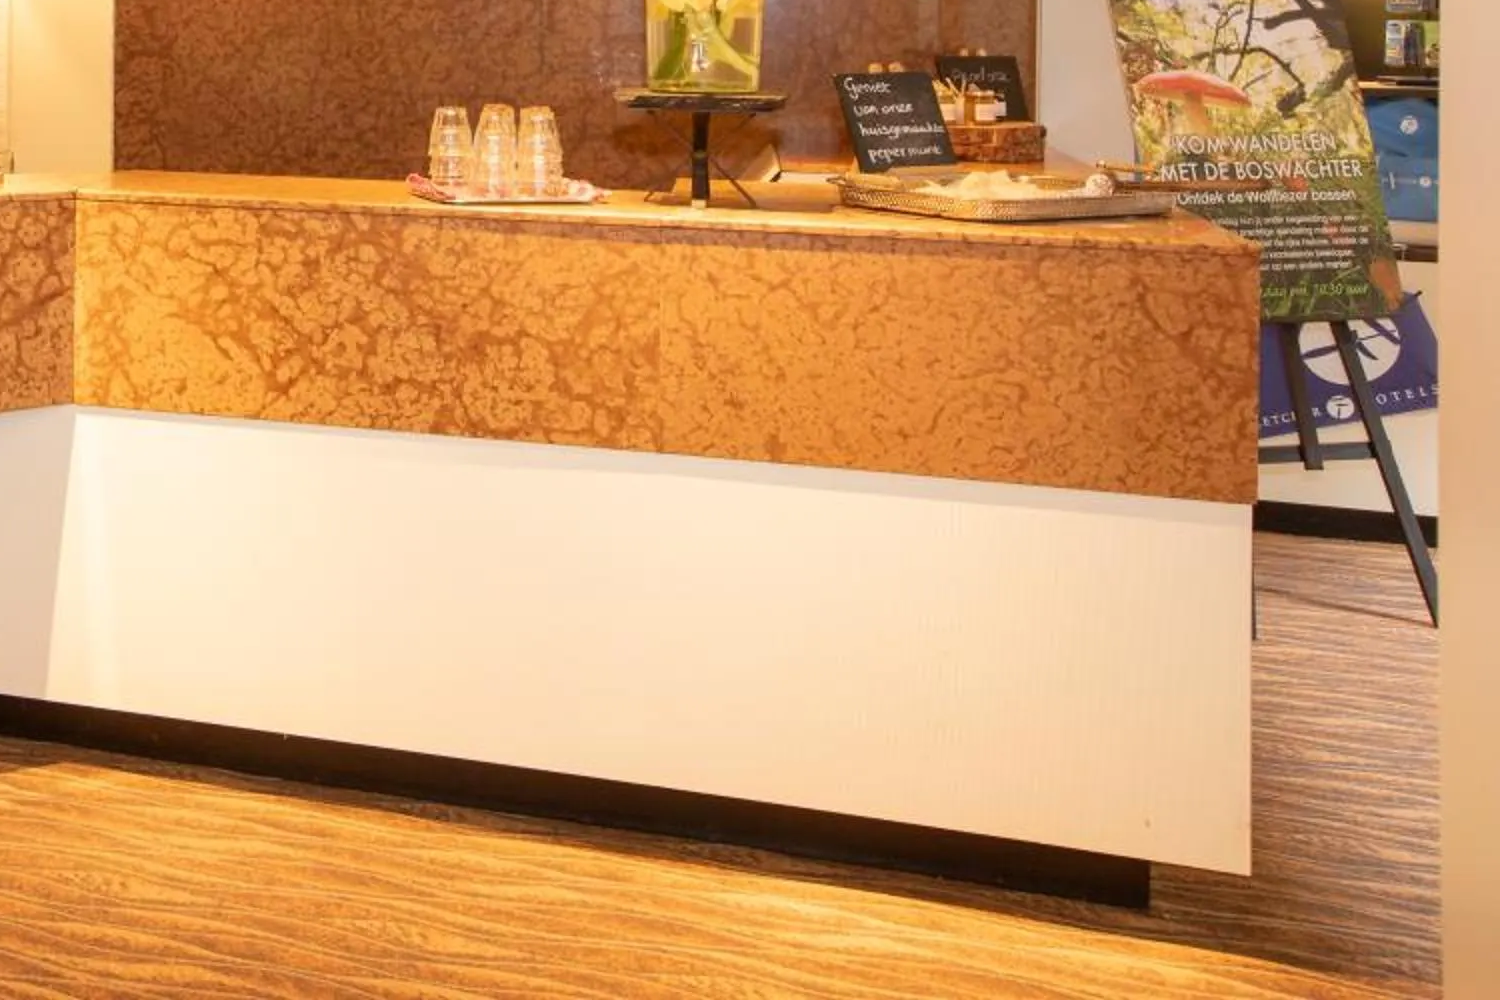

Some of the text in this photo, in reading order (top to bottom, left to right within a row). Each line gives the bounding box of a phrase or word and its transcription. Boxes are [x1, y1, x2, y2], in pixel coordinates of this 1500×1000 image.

[854, 103, 914, 117] van onze
[1176, 132, 1336, 155] KOM WANDELEN
[1160, 158, 1364, 182] MET DE BOSWACHTER
[1176, 190, 1225, 206] Ontdek
[1229, 191, 1245, 204] de
[1375, 383, 1440, 405] OTELS
